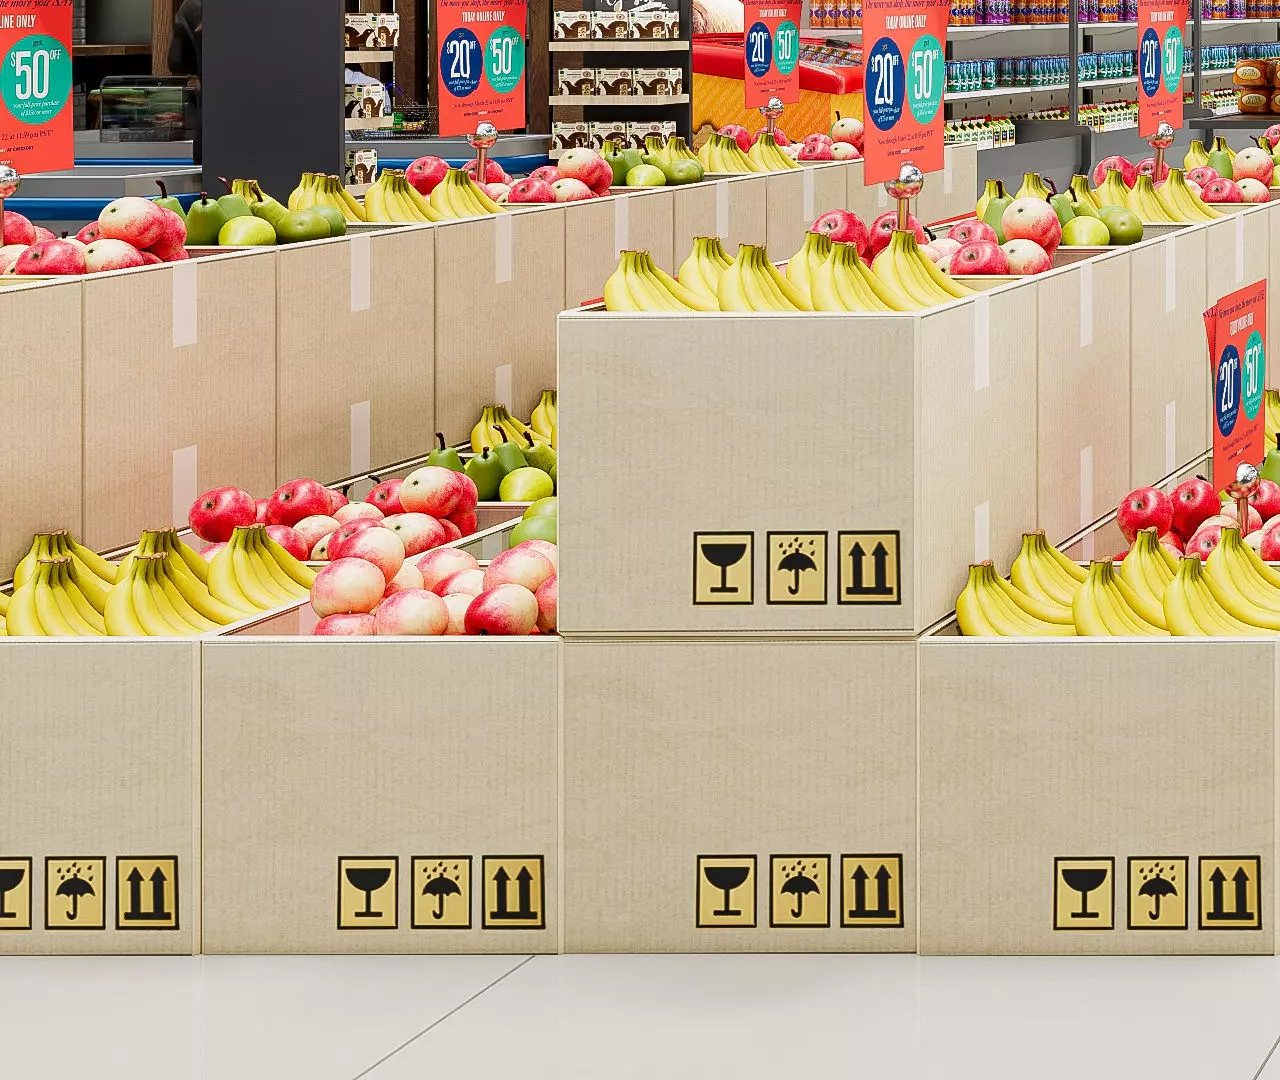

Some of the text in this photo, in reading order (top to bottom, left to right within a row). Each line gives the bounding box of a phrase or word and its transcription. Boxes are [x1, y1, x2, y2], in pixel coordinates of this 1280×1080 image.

[10, 0, 31, 8] more
[16, 15, 37, 28] ONLY
[476, 11, 492, 22] ONLINE
[50, 49, 62, 61] OFF
